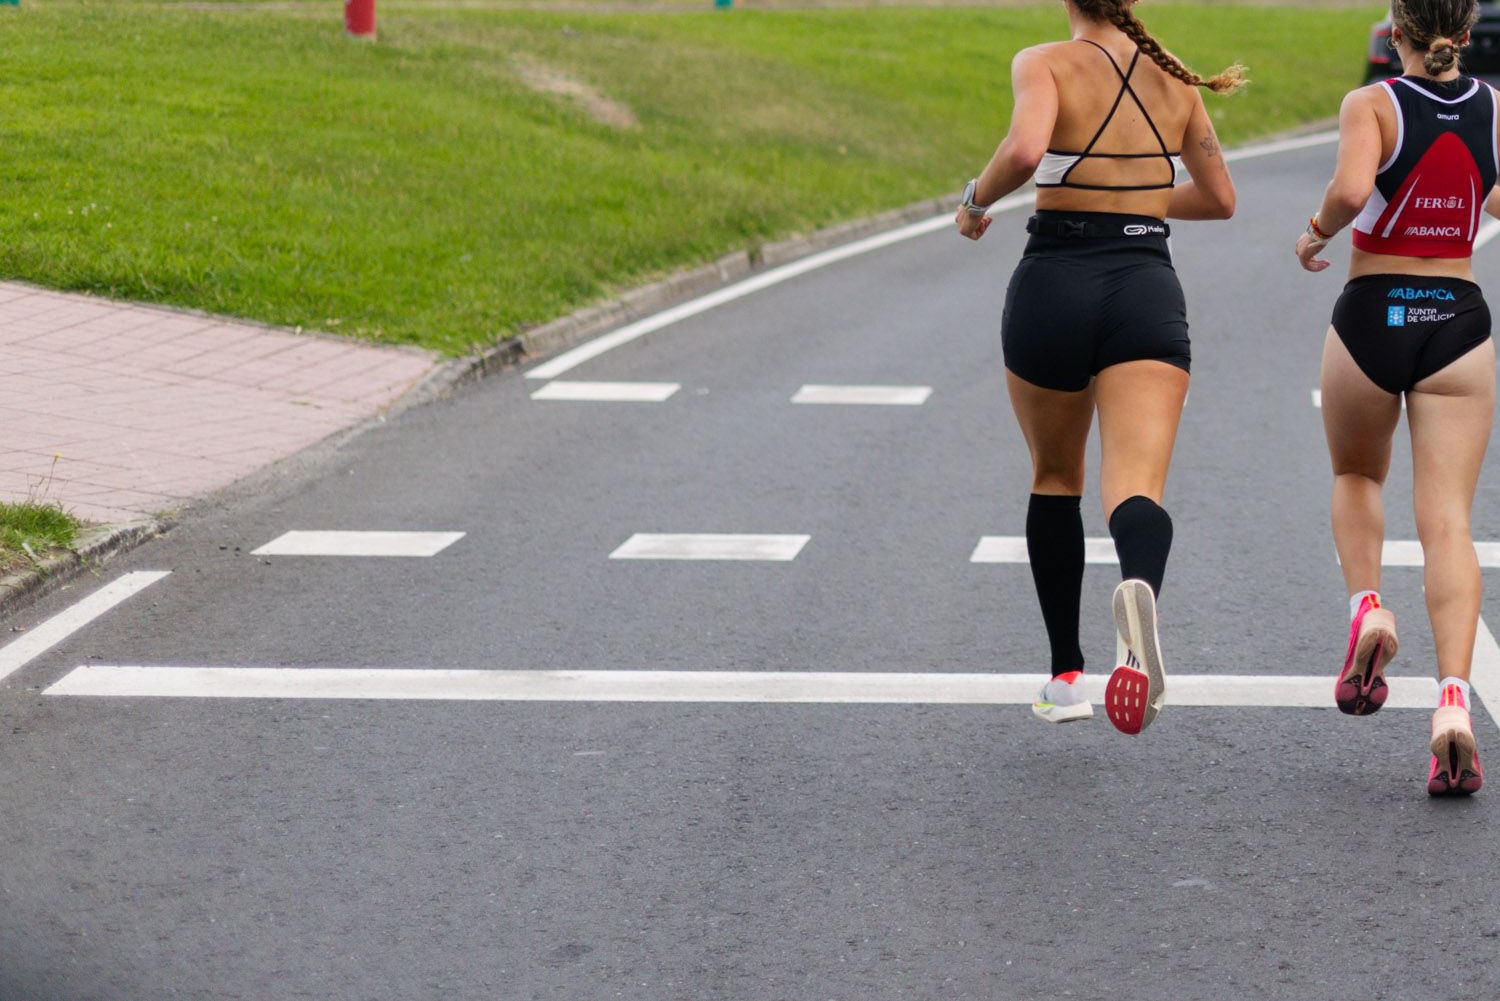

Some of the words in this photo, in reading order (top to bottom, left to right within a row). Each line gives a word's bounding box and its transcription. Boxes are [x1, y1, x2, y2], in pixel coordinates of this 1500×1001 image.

[1437, 113, 1460, 121] amura
[1408, 307, 1437, 315] XUNTA
[1407, 315, 1419, 323] DE
